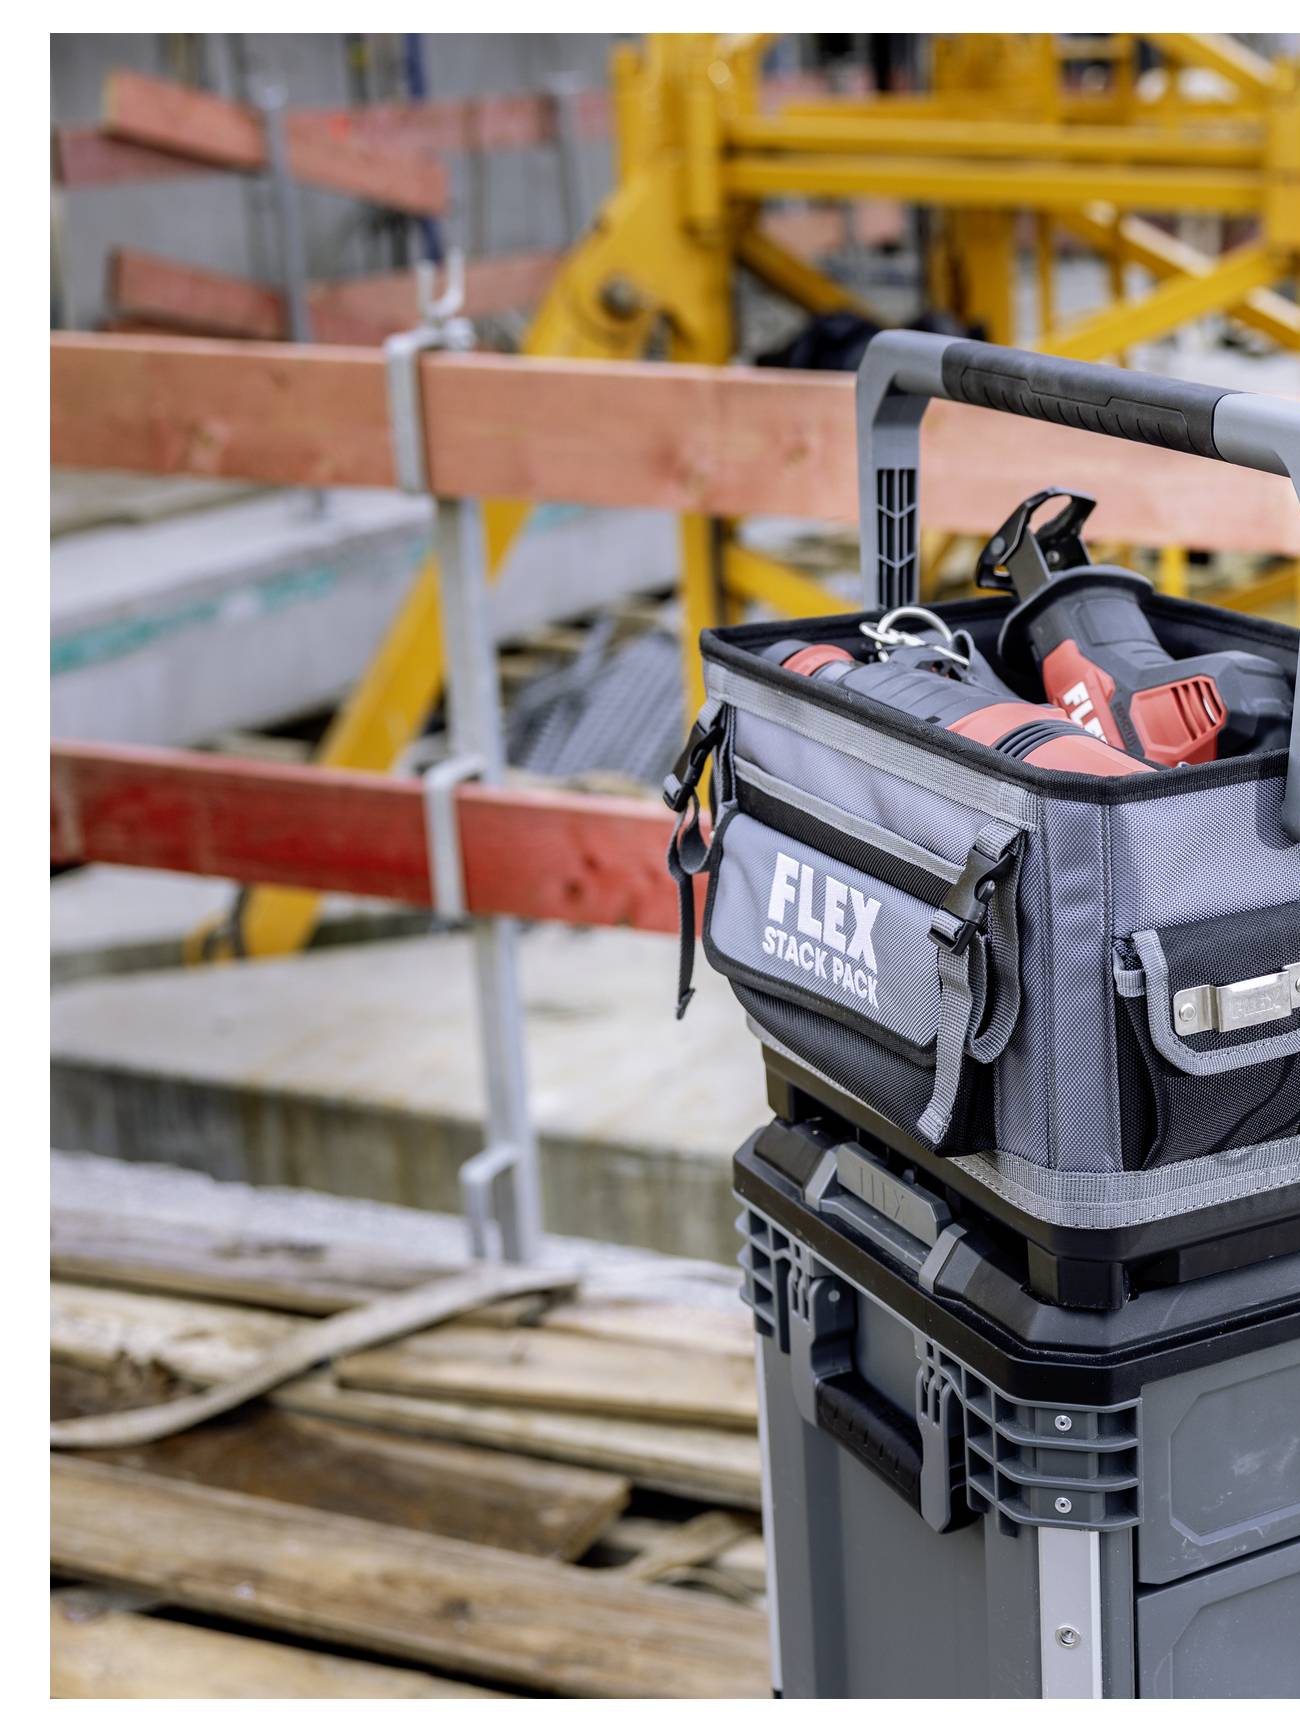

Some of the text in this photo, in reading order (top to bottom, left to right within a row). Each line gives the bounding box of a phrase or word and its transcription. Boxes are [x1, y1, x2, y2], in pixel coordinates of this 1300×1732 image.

[767, 851, 882, 974] FLEX
[762, 925, 880, 1009] STACK PACK
